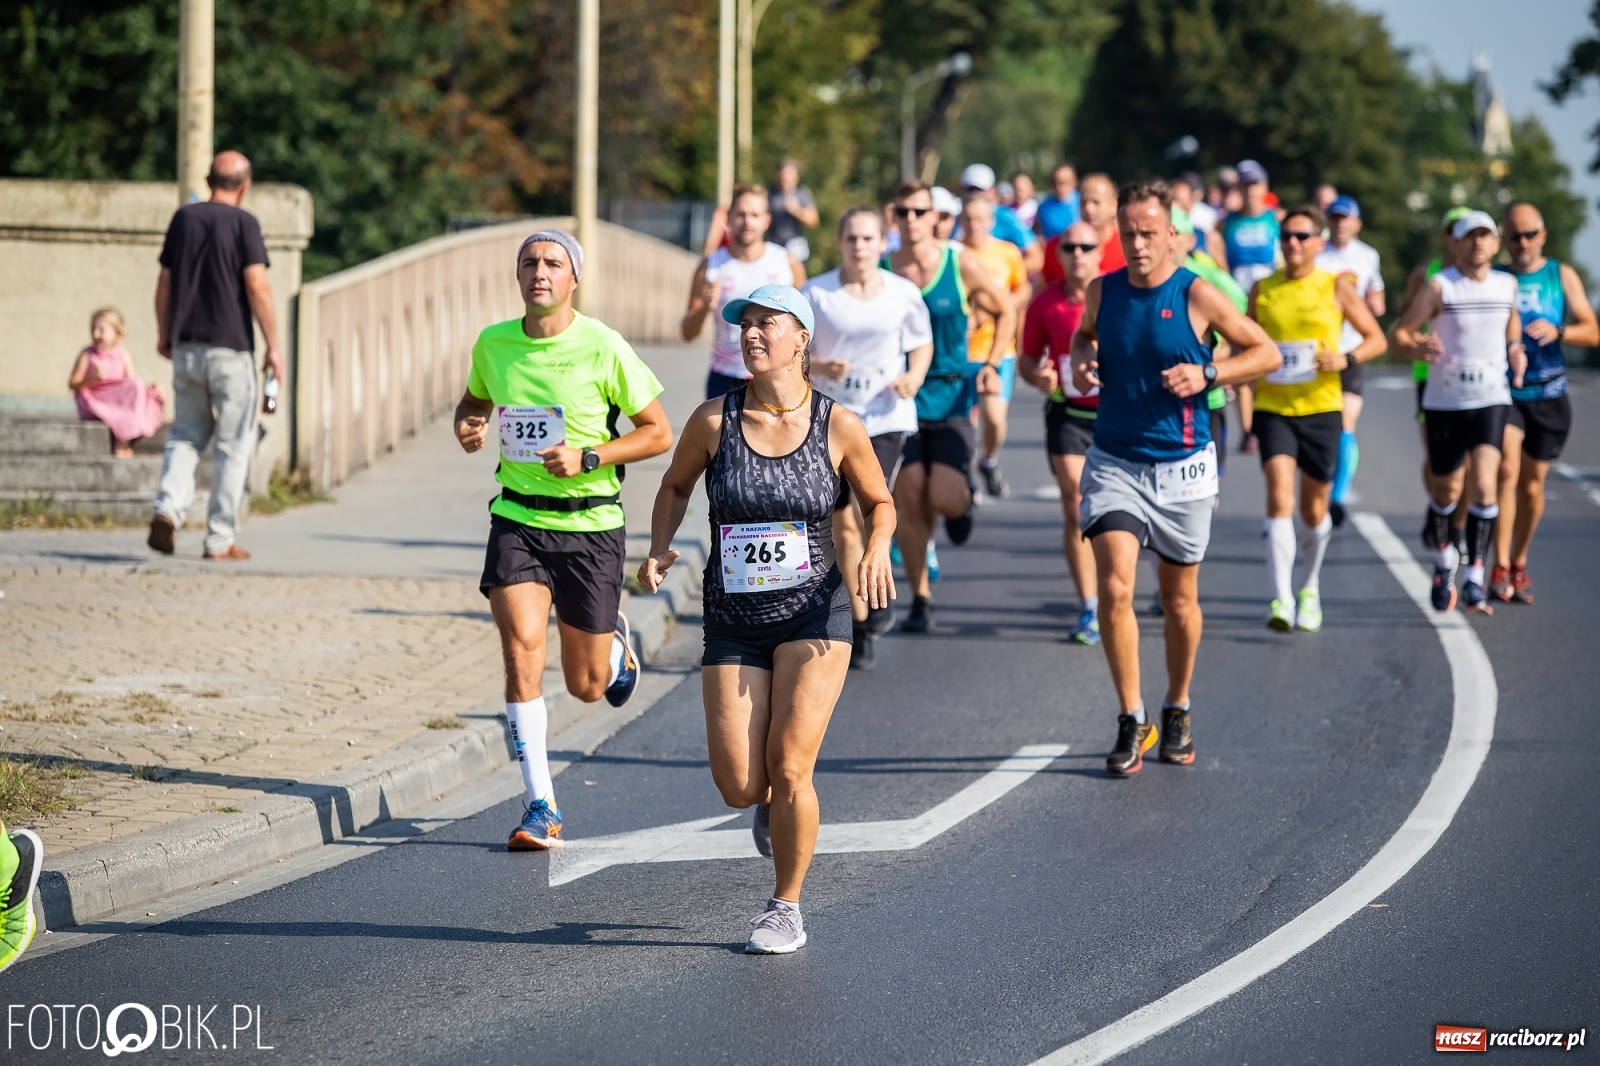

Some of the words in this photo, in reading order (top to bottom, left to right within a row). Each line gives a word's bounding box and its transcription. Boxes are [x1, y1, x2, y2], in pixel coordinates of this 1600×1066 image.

[515, 421, 548, 439] 325
[1181, 462, 1205, 481] 109
[743, 541, 787, 564] 265
